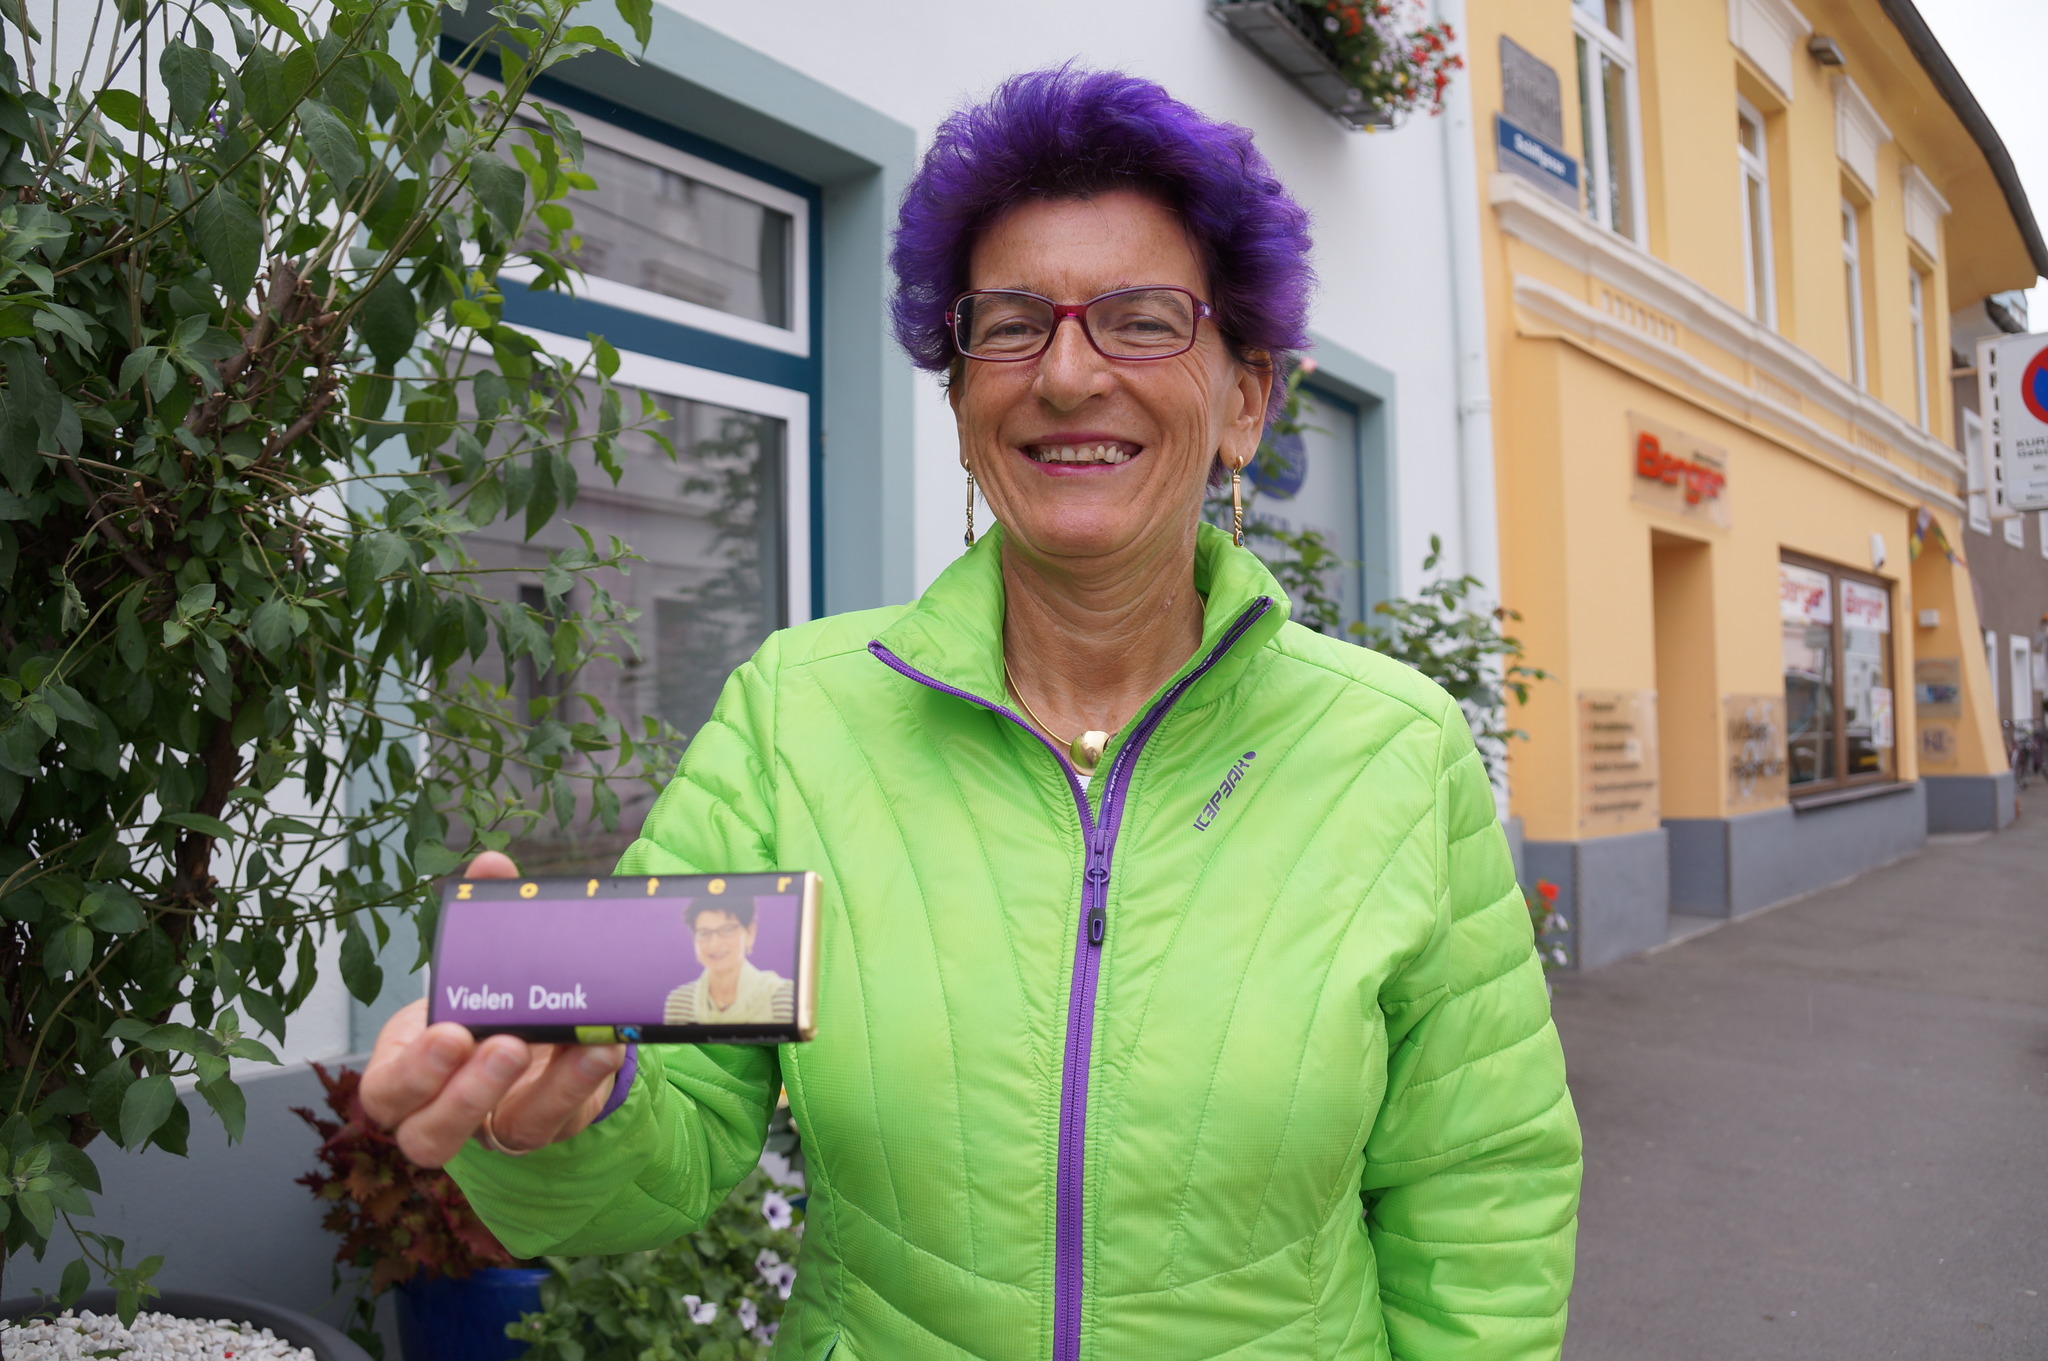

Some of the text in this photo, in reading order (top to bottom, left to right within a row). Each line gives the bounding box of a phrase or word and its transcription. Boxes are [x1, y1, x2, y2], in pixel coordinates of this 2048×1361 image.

[1637, 430, 1726, 504] Berger
[1193, 759, 1250, 832] ICEPEAK
[446, 982, 588, 1011] Vielen Dank
